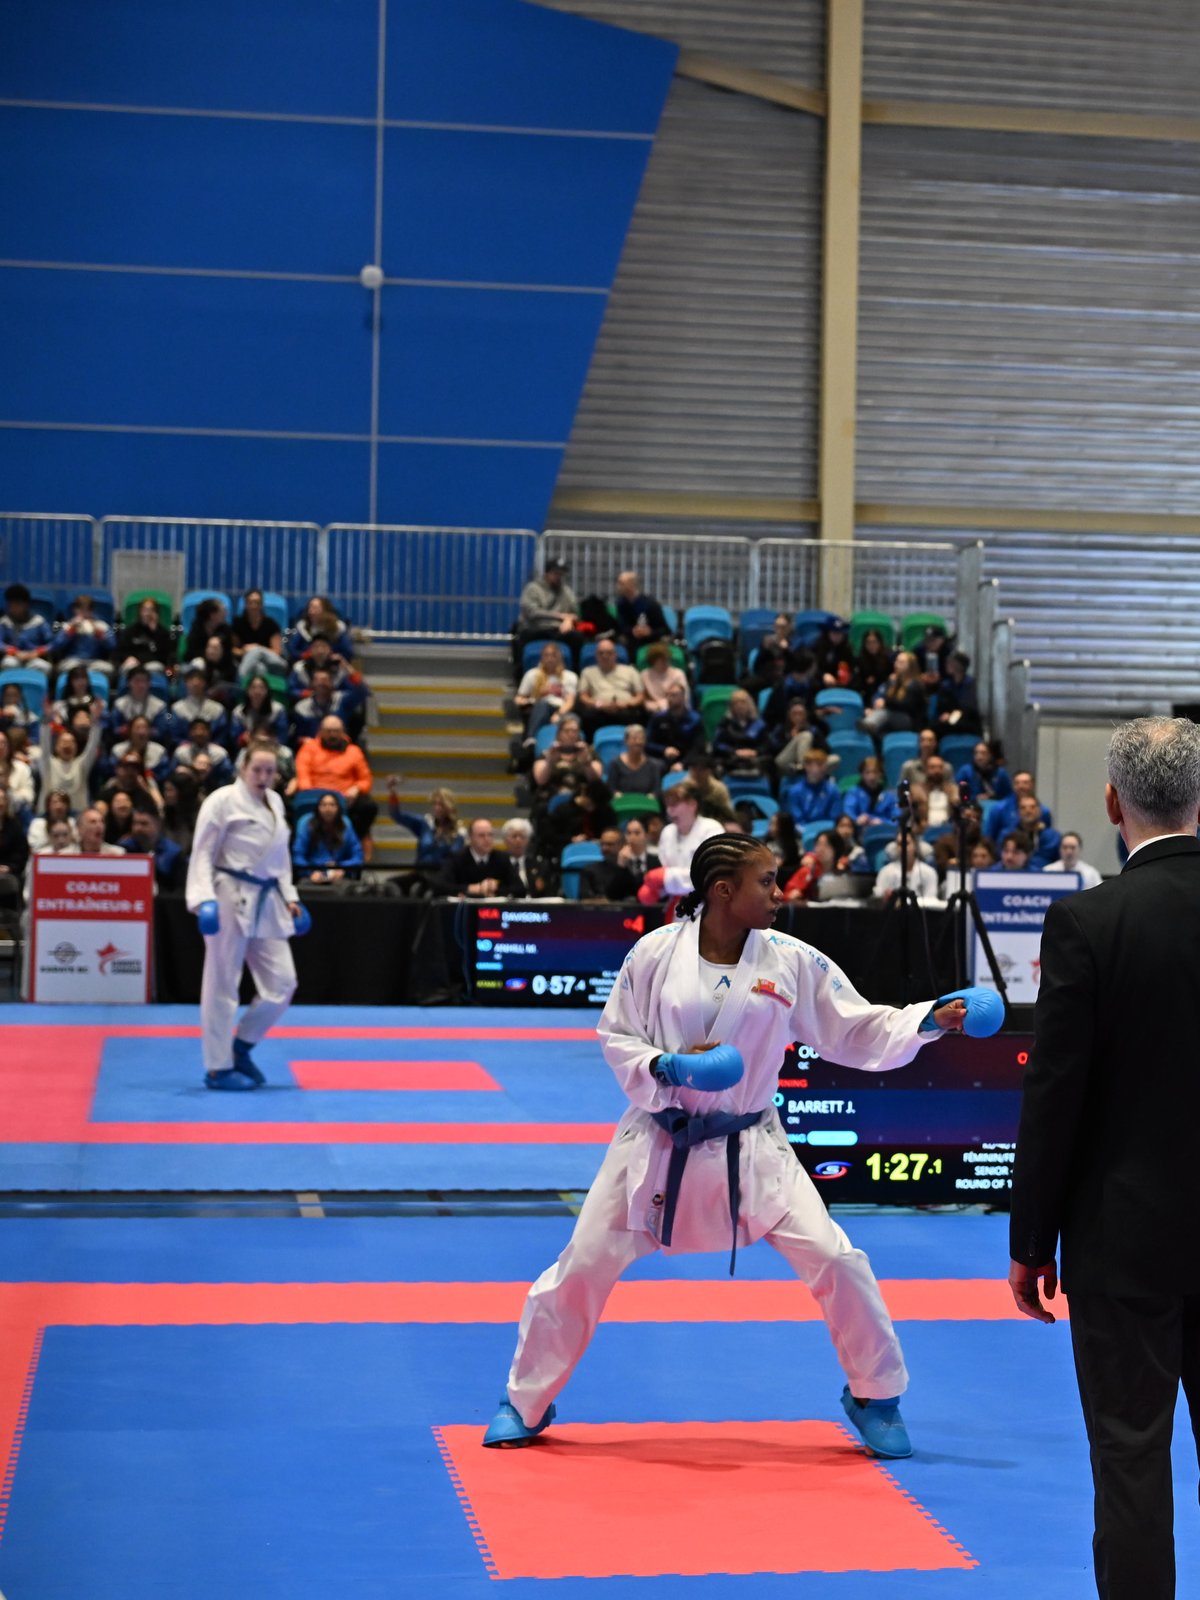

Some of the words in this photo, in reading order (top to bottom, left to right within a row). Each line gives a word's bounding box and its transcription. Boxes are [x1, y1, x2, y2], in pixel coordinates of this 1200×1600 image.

[66, 881, 120, 894] COACH
[1003, 894, 1052, 907] COACH
[788, 1100, 844, 1114] BARRETT
[845, 1100, 856, 1114] J.
[974, 1166, 1009, 1177] SENIOR
[955, 1178, 991, 1190] ROUND
[991, 1178, 1005, 1190] OF
